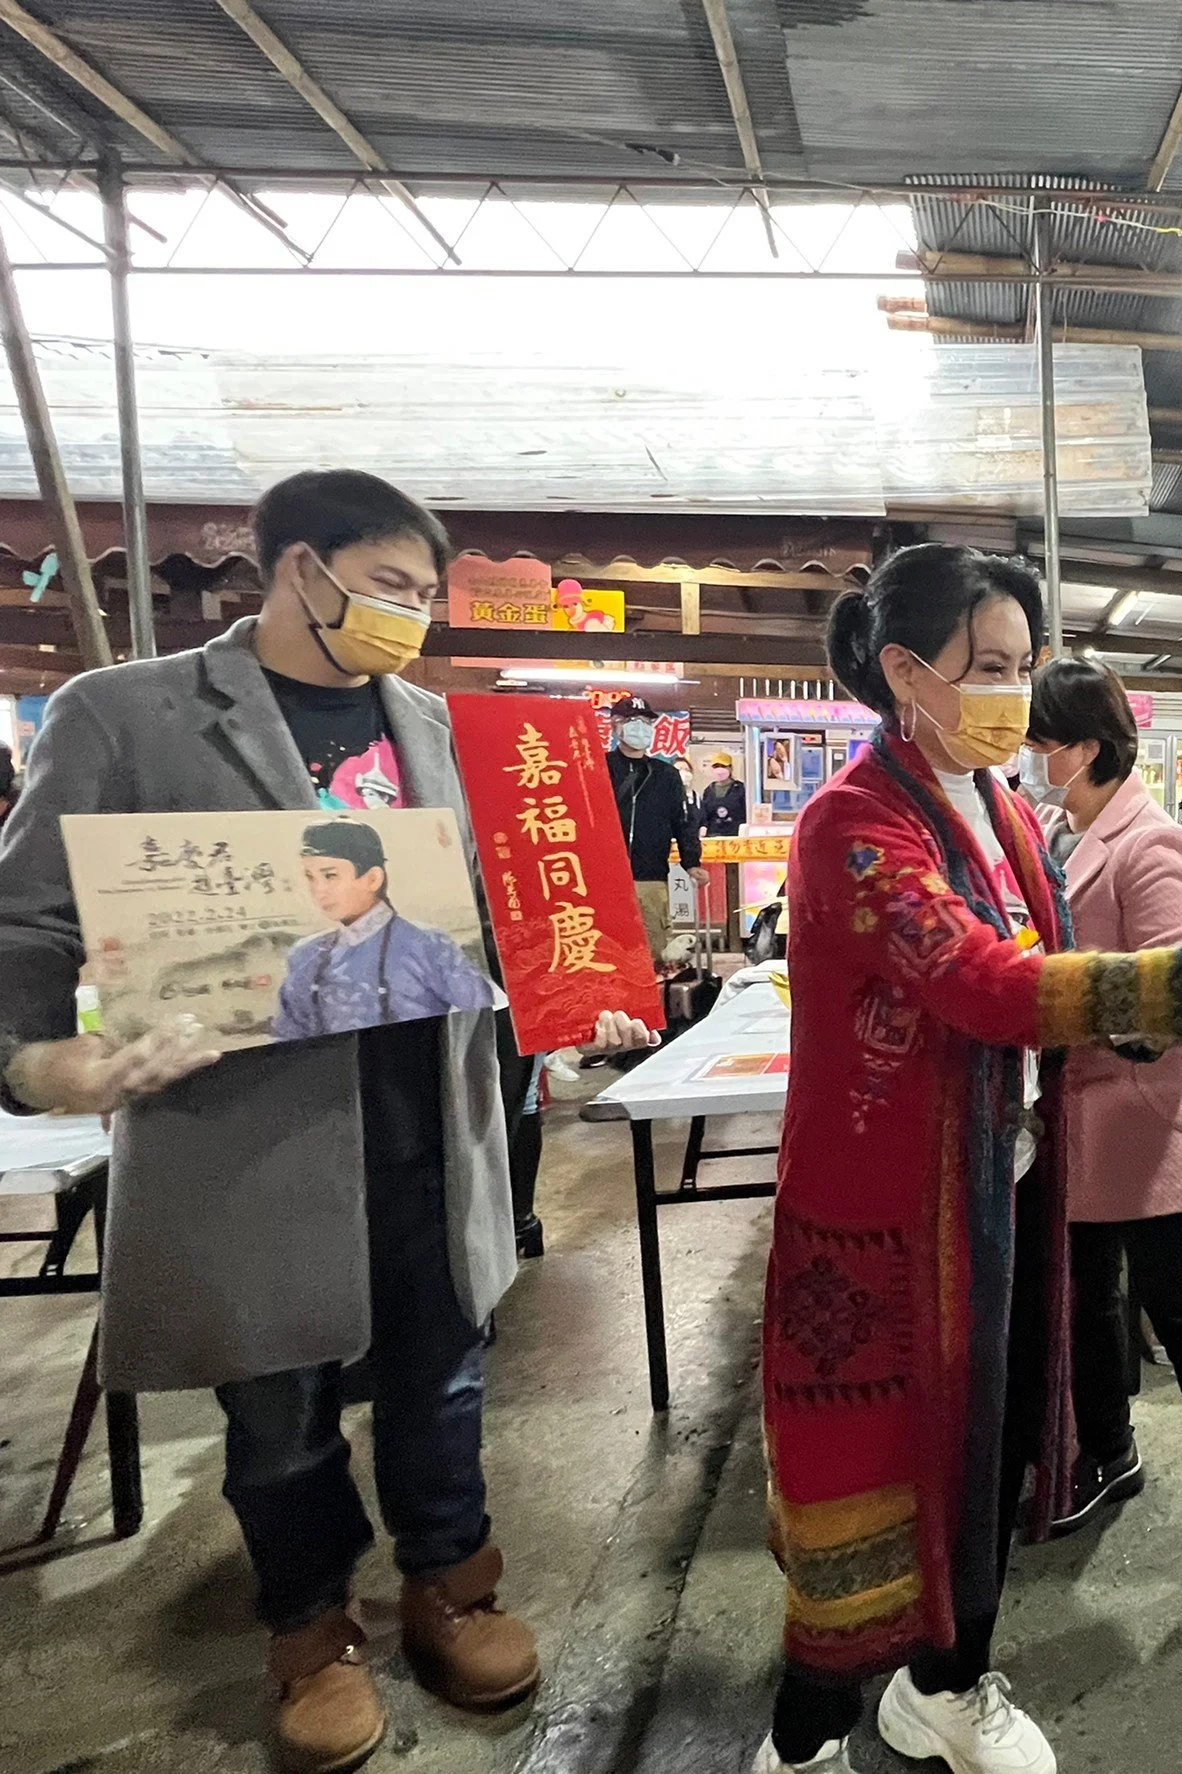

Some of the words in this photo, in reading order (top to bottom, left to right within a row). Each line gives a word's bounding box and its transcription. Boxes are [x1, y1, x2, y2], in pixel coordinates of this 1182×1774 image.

[470, 602, 549, 625] 黃金蛋
[502, 722, 618, 974] 嘉福同慶
